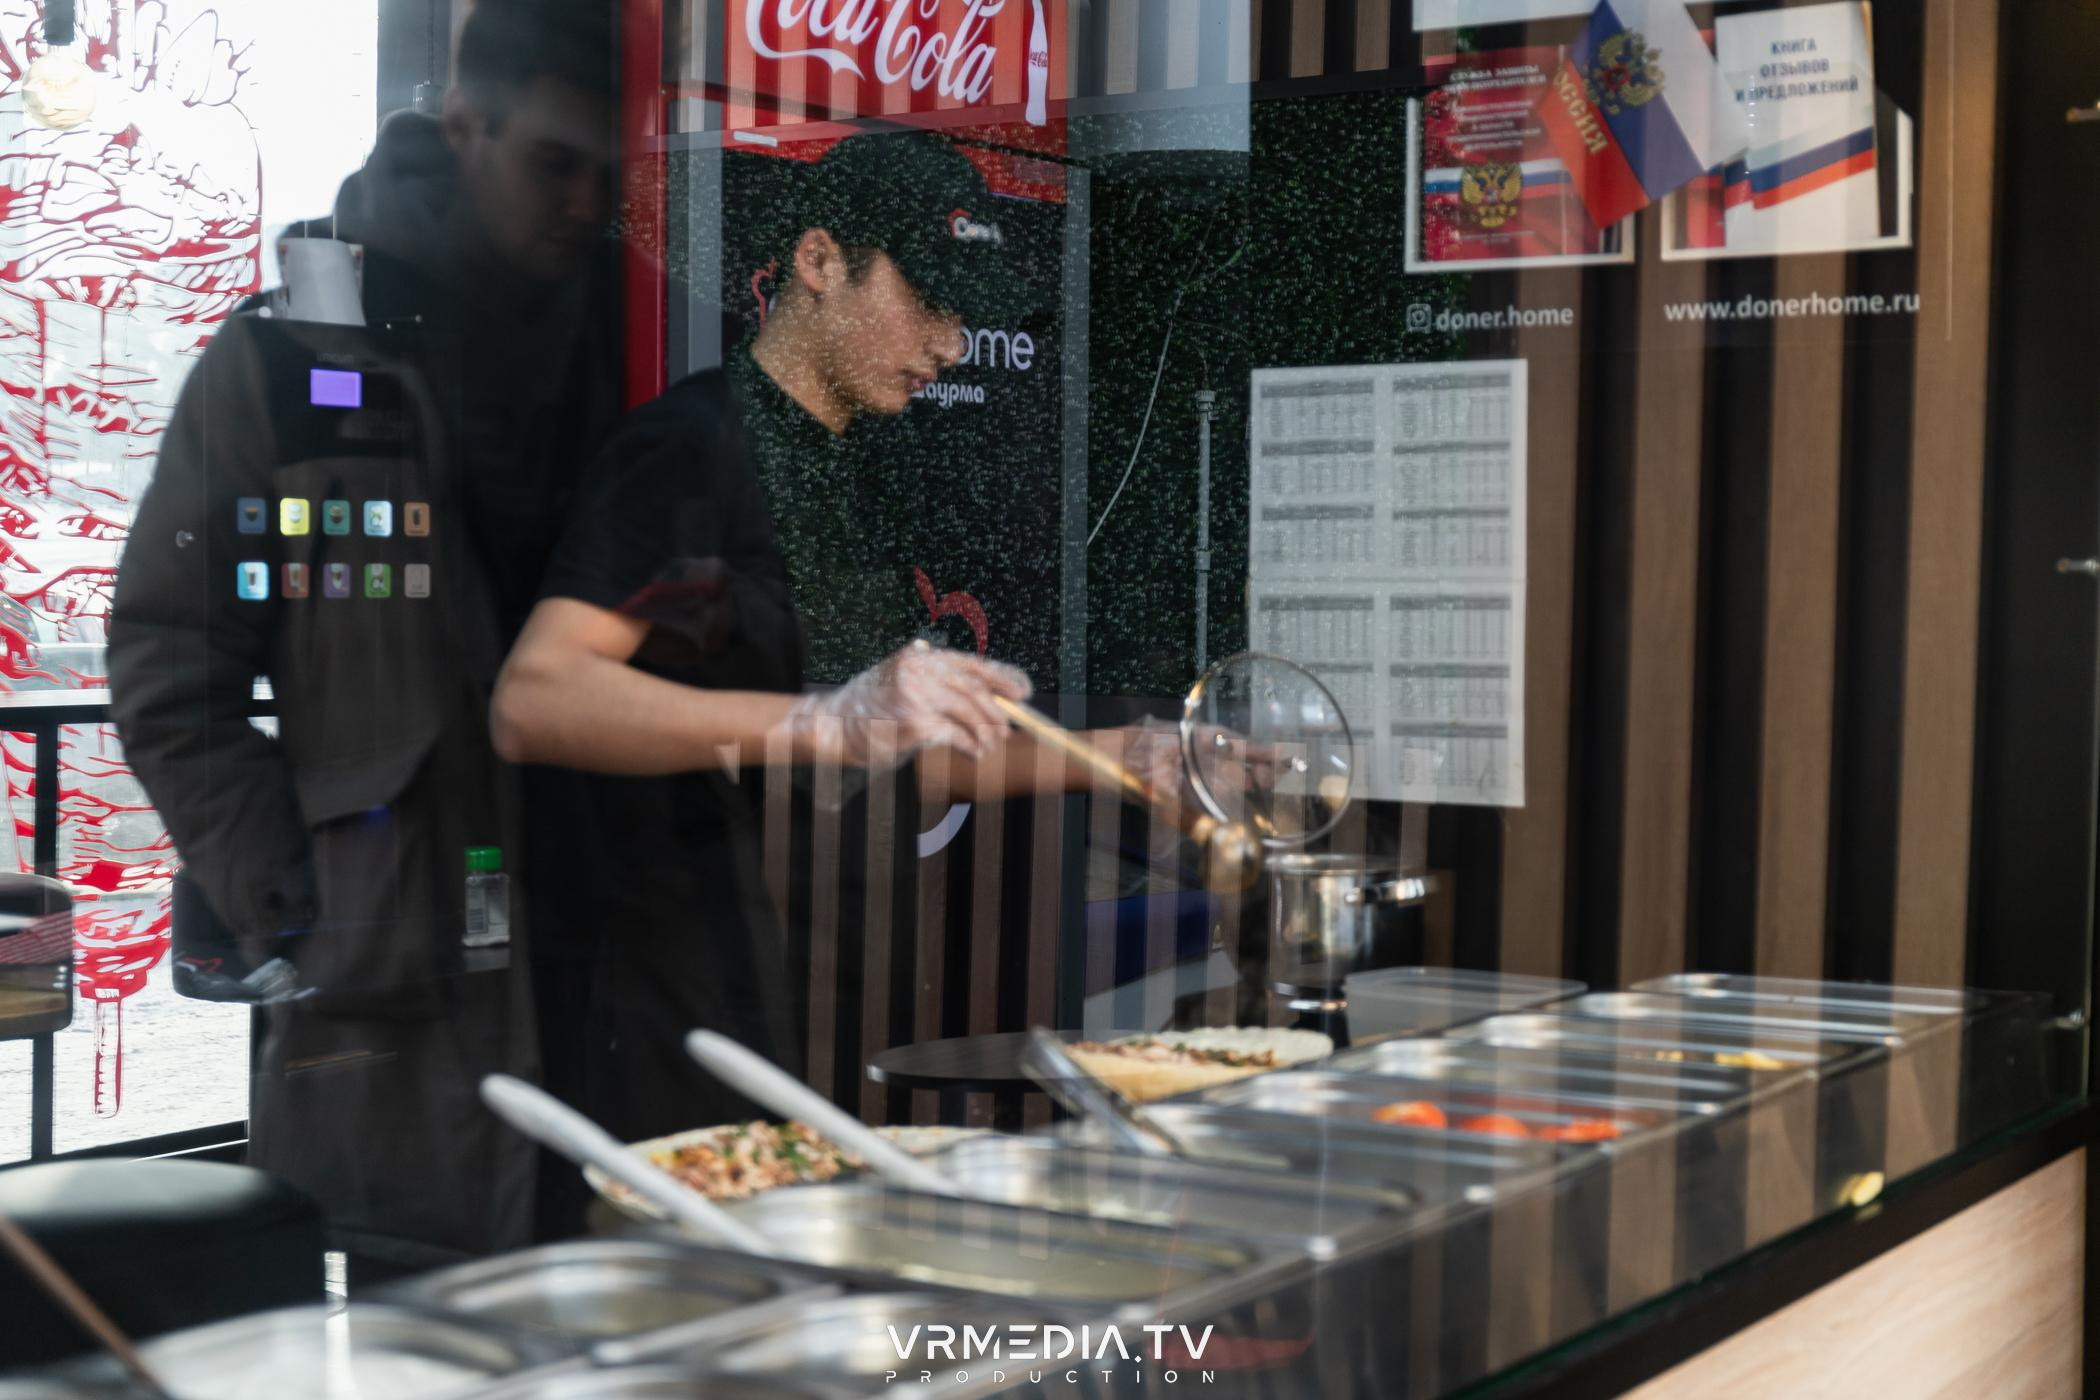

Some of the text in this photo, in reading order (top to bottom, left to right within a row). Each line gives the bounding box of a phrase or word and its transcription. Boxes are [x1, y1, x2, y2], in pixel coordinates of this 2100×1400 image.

[1770, 38, 1817, 56] КНИГА
[1759, 58, 1830, 78] ОТЗЫВОВ
[1748, 75, 1859, 101] ПРЕДЛОЖЕНИЙ
[1435, 304, 1574, 331] doner.home
[1663, 291, 1921, 321] www.donerhome.ru
[959, 325, 1035, 371] ome
[910, 382, 985, 408] аурма
